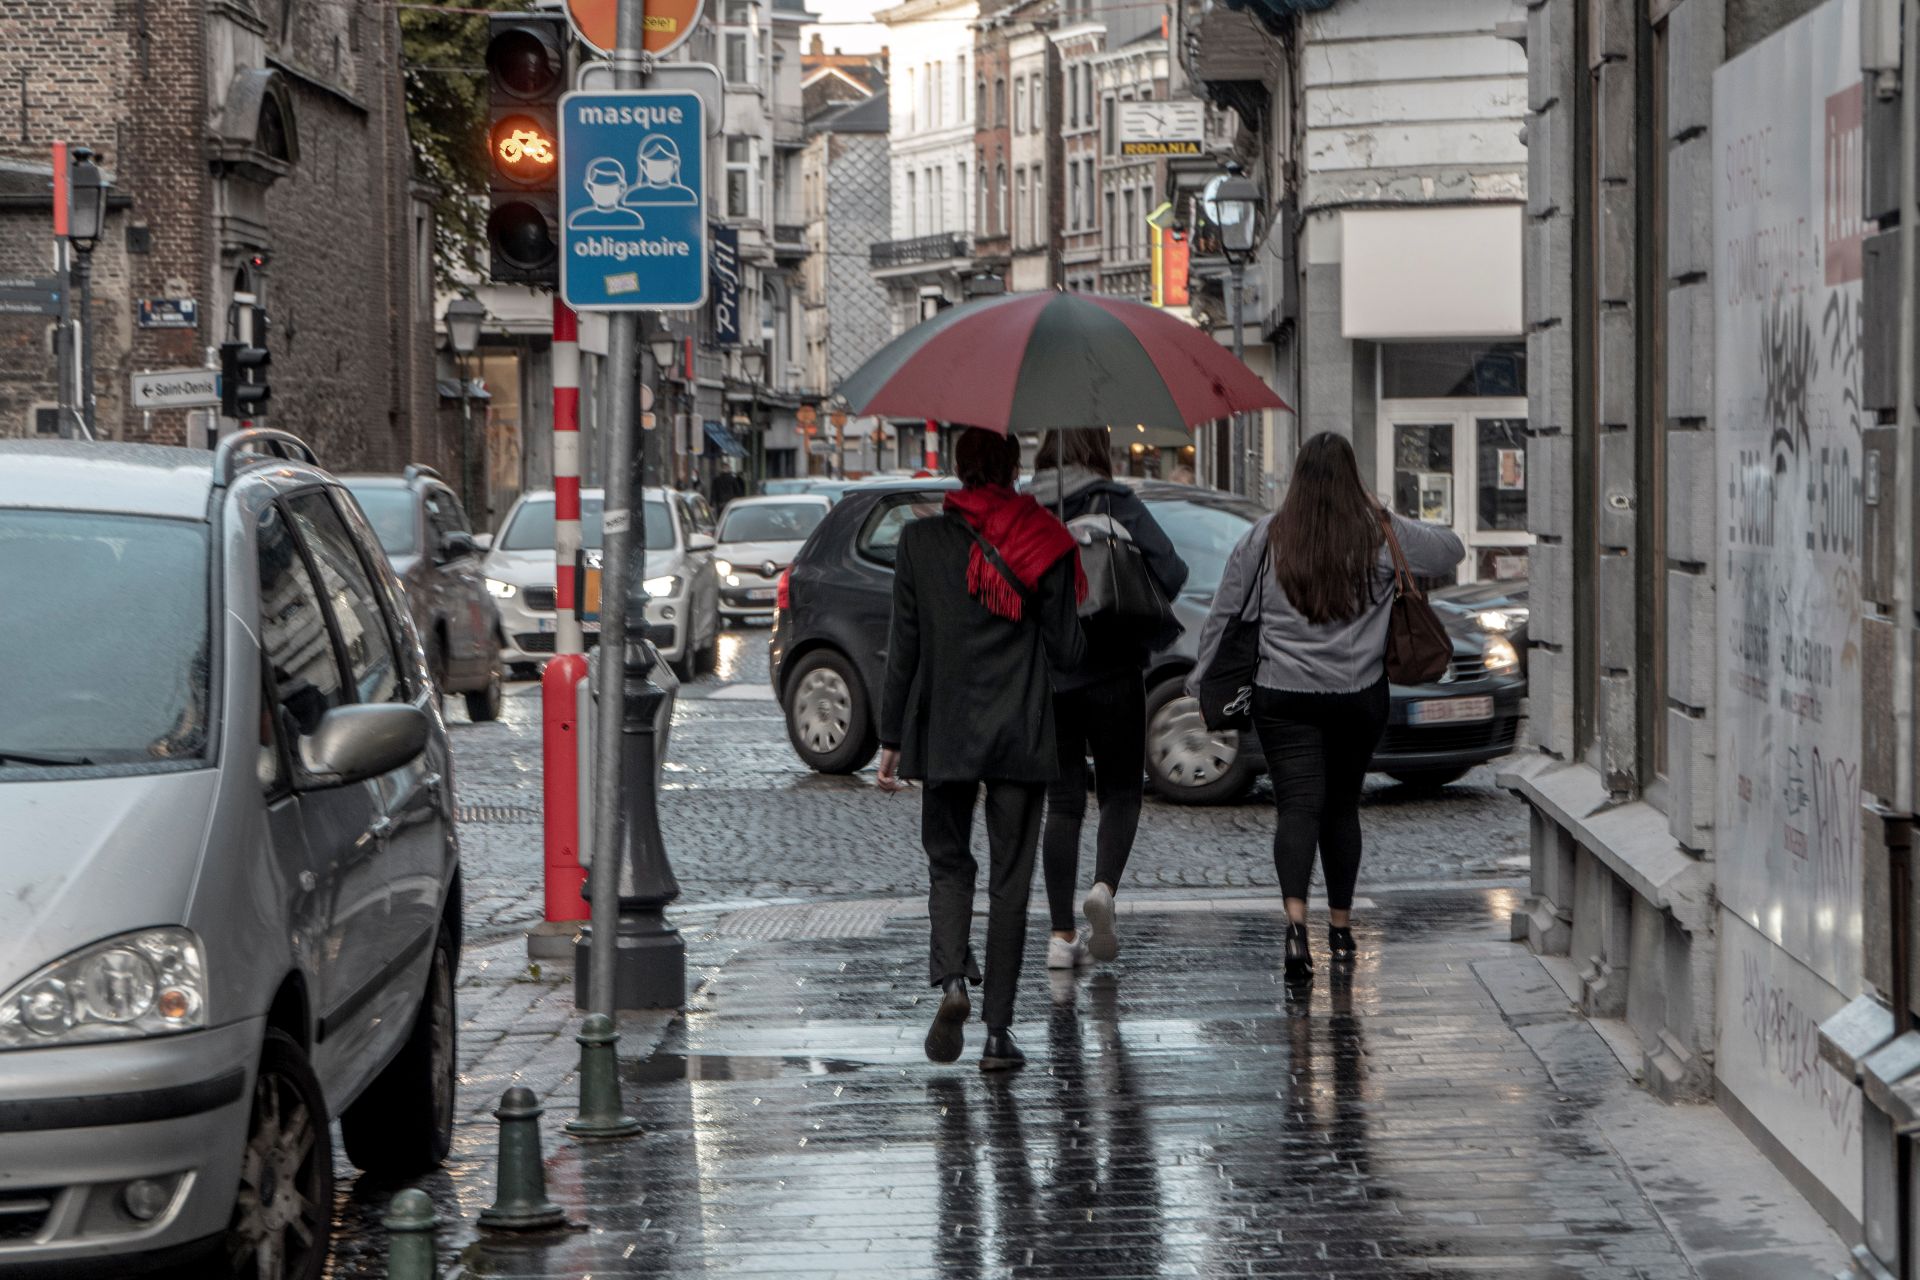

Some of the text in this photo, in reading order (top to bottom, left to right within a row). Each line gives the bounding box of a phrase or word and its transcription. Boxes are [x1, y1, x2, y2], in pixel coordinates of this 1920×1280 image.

[579, 106, 683, 130] masque
[1124, 142, 1199, 155] RODANIA
[574, 235, 690, 261] obligatoire
[714, 239, 739, 334] Profil
[155, 381, 214, 397] Saint-Denis
